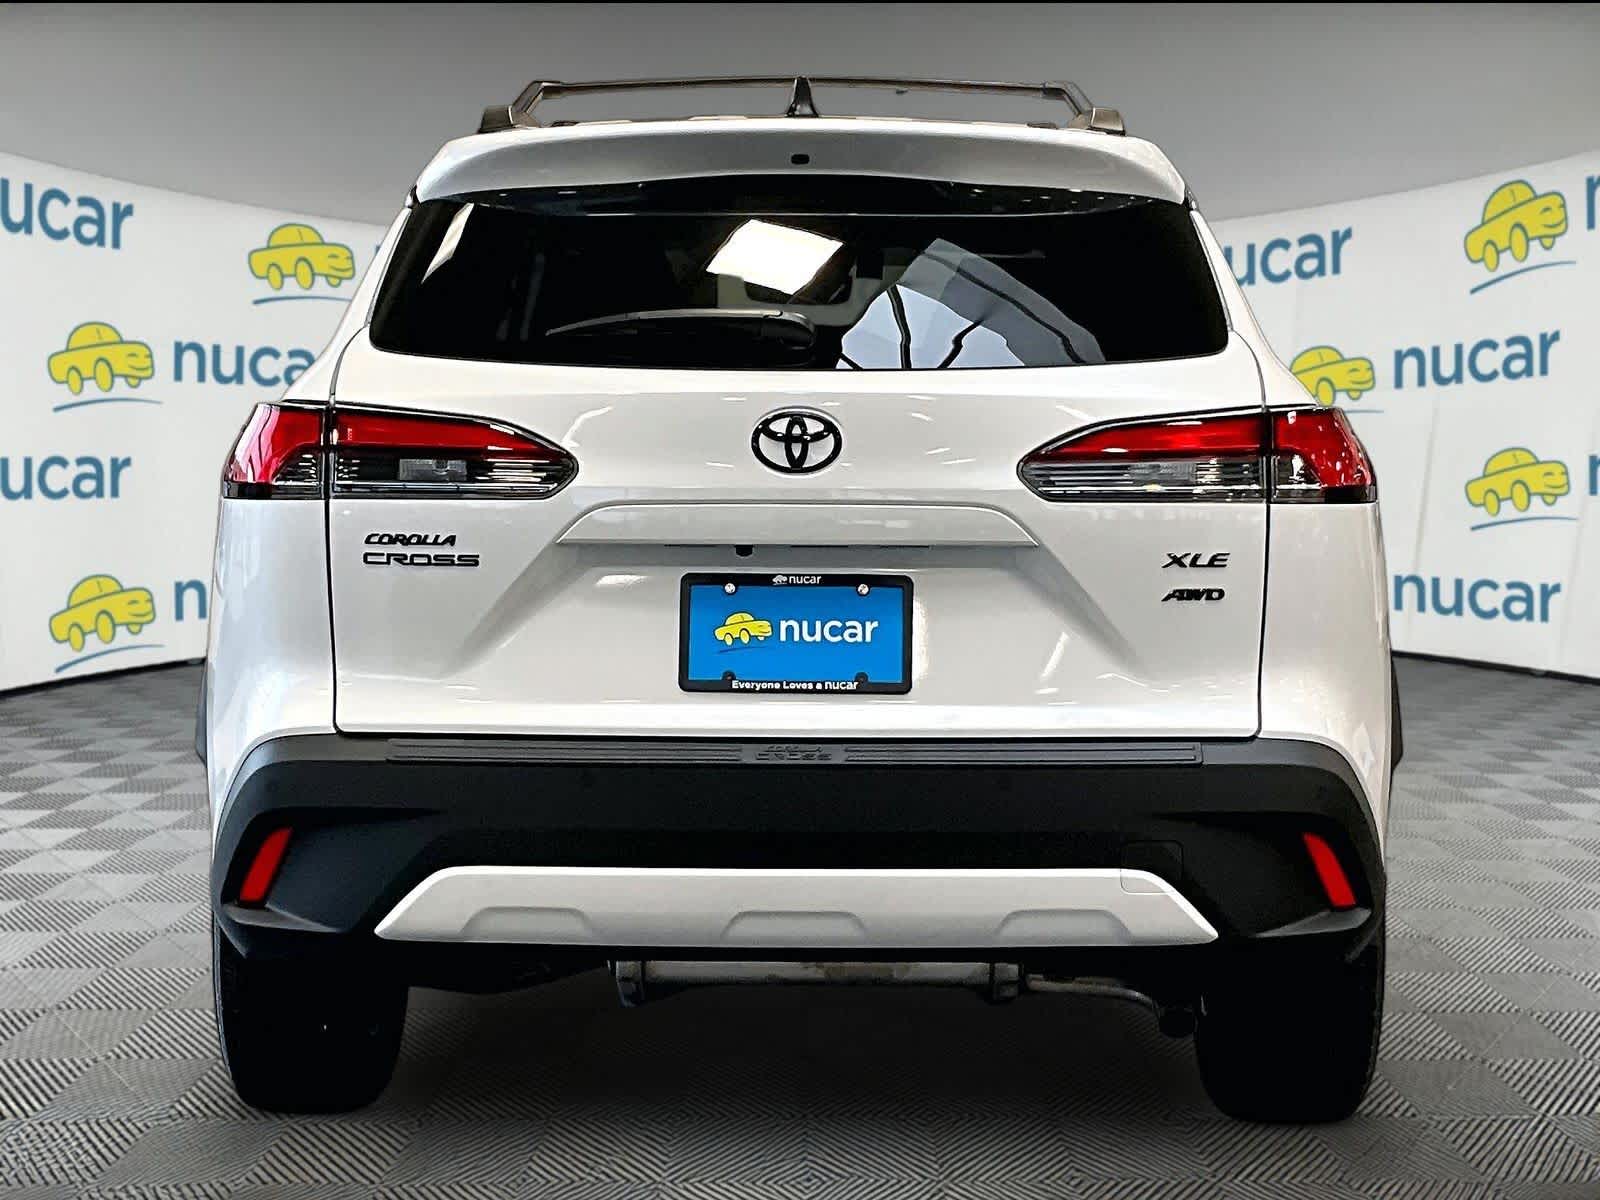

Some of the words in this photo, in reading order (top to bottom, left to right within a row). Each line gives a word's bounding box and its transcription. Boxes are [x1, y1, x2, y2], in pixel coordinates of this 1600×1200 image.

[0, 177, 134, 250] ucar
[1223, 226, 1353, 287] ucar
[173, 340, 316, 387] nuca
[1393, 329, 1560, 390] nucar
[0, 455, 132, 501] ucar
[364, 533, 457, 547] COROLLA
[362, 552, 480, 567] CROSS
[1161, 552, 1231, 568] XLE
[788, 575, 822, 585] nucar
[1161, 588, 1226, 602] AWD
[1393, 573, 1562, 623] nucar
[779, 619, 879, 643] nucar
[731, 680, 781, 691] Everyone
[782, 681, 814, 690] Loves
[815, 682, 822, 690] a
[824, 680, 859, 690] nucar
